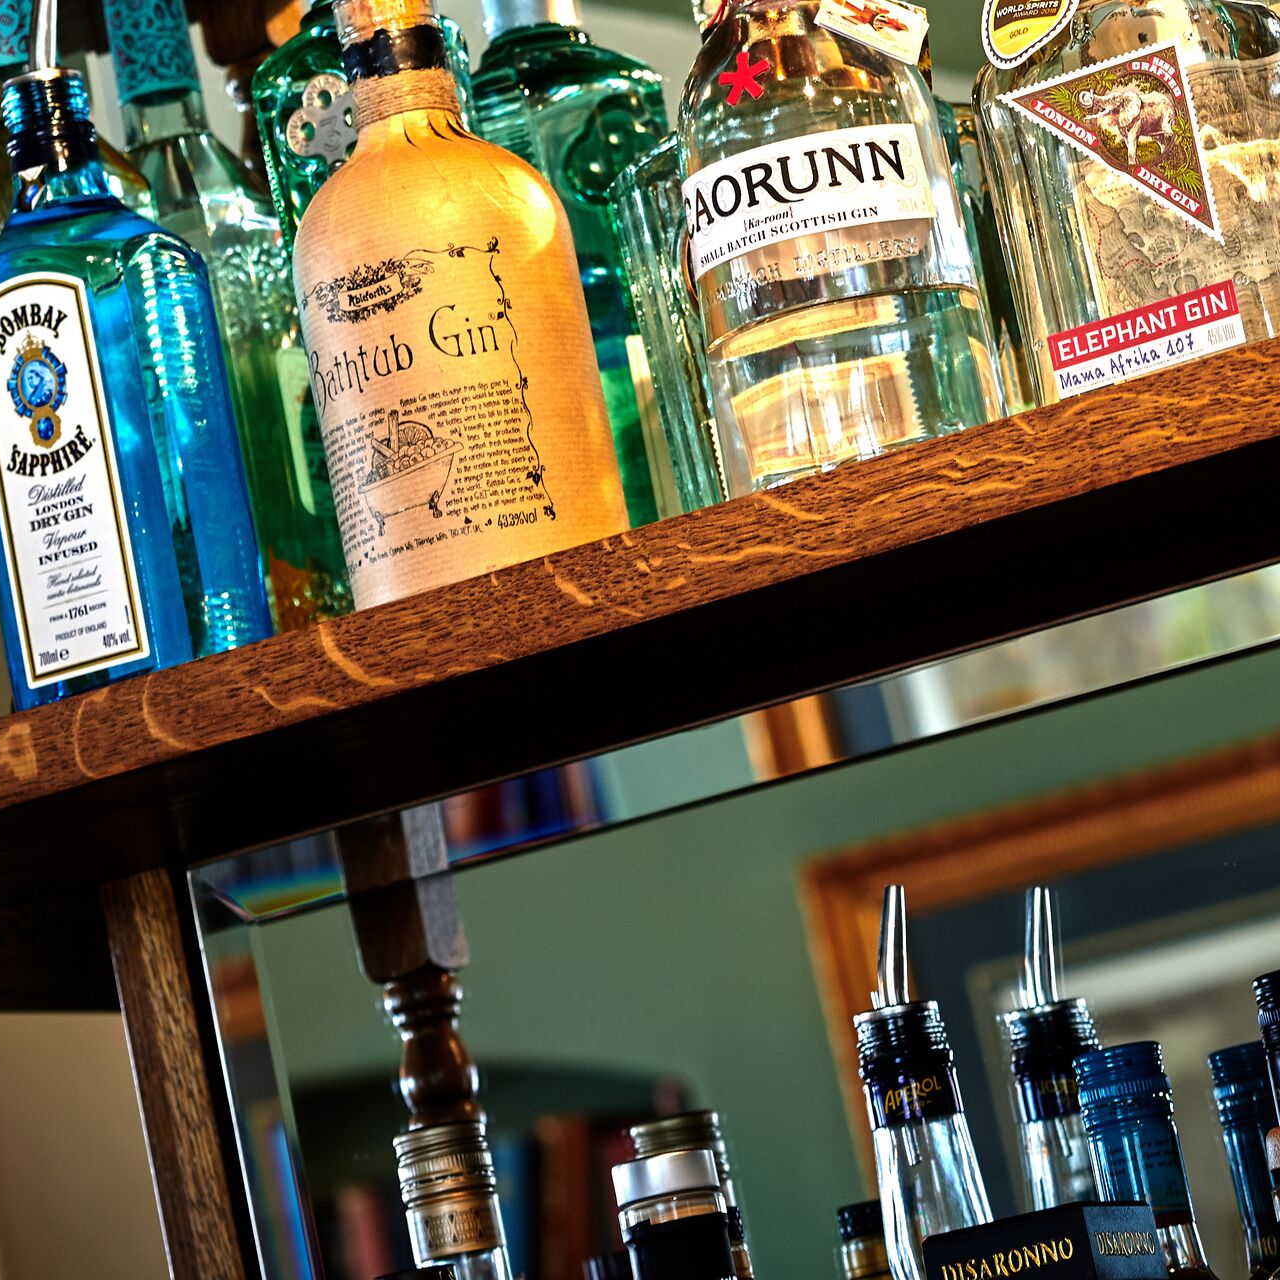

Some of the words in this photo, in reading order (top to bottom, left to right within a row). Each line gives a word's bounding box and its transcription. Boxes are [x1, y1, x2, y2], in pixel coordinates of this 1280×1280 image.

[996, 5, 1024, 19] WORLD
[1026, 0, 1059, 11] SPIRITS
[1012, 9, 1039, 19] AWARD
[1009, 26, 1029, 40] GOLD
[1131, 62, 1182, 98] CRAFTED
[1151, 56, 1177, 77] HAND
[1033, 99, 1098, 146] LONDON
[683, 140, 906, 241] CAORUNN
[1136, 166, 1173, 195] DRY
[1170, 188, 1200, 213] GIN
[700, 247, 726, 268] SMALL
[726, 231, 767, 253] BATCH
[770, 212, 847, 237] SCOTTISH
[851, 206, 879, 220] GIN
[1057, 305, 1180, 363] ELEPHANT
[1183, 289, 1229, 322] GIN
[308, 334, 414, 419] Bathtub
[428, 304, 499, 358] Gin
[1059, 361, 1105, 391] Mama
[1110, 346, 1161, 376] Afrika
[6, 424, 93, 477] SAPPHIRE
[27, 474, 86, 508] Distilled
[35, 495, 84, 517] LONDON
[29, 512, 62, 533] DRY
[64, 503, 94, 522] GIN
[38, 541, 98, 566] INFUSED
[68, 604, 89, 620] 1761
[885, 1075, 942, 1114] APEROL
[941, 1236, 1074, 1280] DISARONNO
[1094, 1230, 1155, 1257] DISARONNO
